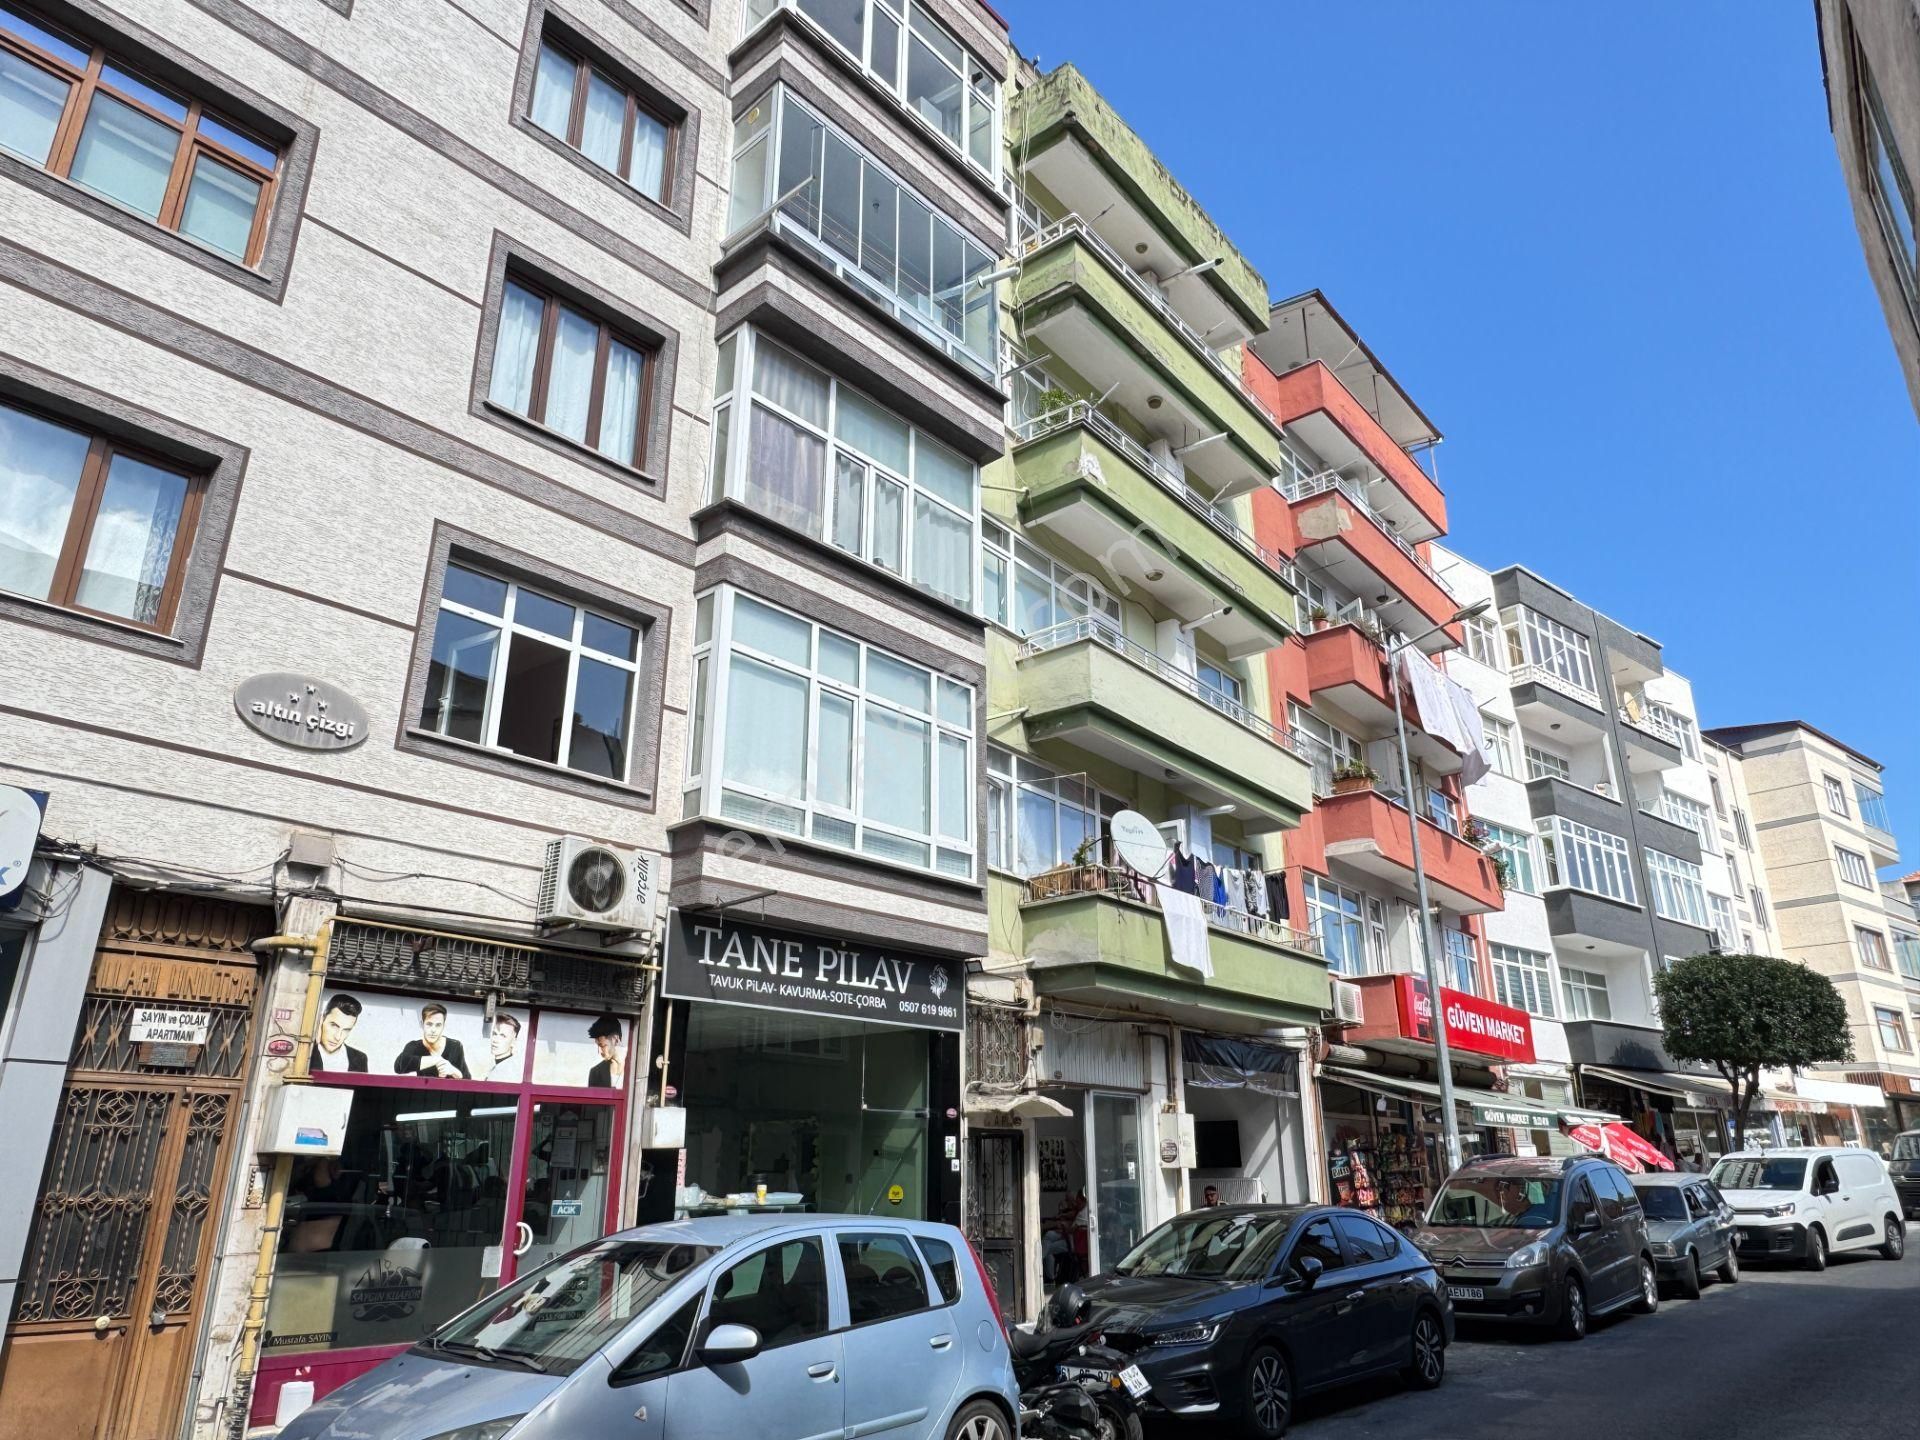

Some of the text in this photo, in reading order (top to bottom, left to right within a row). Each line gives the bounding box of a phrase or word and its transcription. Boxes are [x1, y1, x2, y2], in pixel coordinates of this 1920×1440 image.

[306, 714, 356, 739] çizgi
[636, 854, 649, 905] arçelik
[694, 924, 915, 994] TANE PİLAV
[709, 973, 744, 991] TAVUK
[141, 1011, 206, 1029] SAYIN ve ÇOLAK
[899, 1001, 957, 1018] 0507 619 9861
[145, 1027, 195, 1041] APARTMANI
[1447, 1003, 1525, 1045] GÜVEN MARKET
